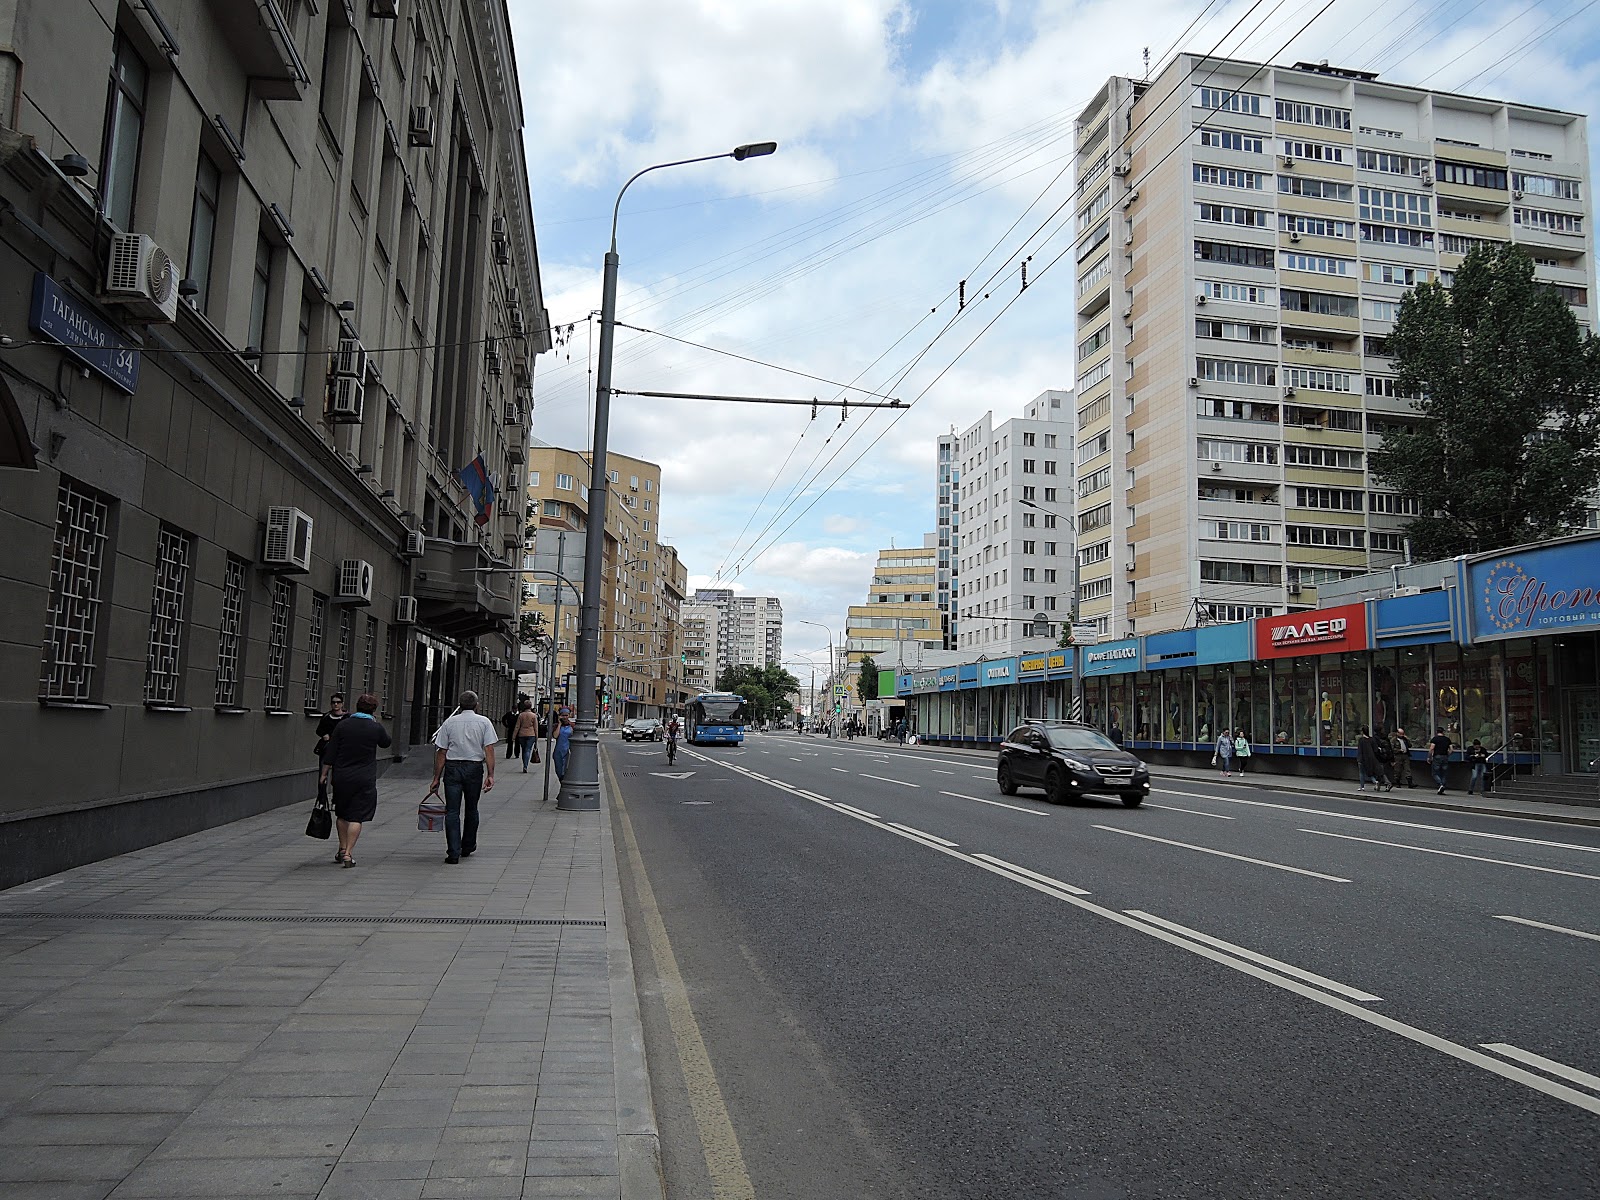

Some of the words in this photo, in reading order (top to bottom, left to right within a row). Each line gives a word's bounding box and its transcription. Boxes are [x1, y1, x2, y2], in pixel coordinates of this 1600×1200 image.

[52, 294, 106, 348] ТАГАНСКАЯ
[66, 328, 88, 351] УЛИЦА
[116, 343, 134, 375] 34
[110, 367, 132, 387] СТРОЕНИЕ
[1497, 574, 1600, 628] Европ
[1283, 618, 1347, 640] АЛЕФ
[1538, 612, 1586, 625] ТОРГОВЫЙ
